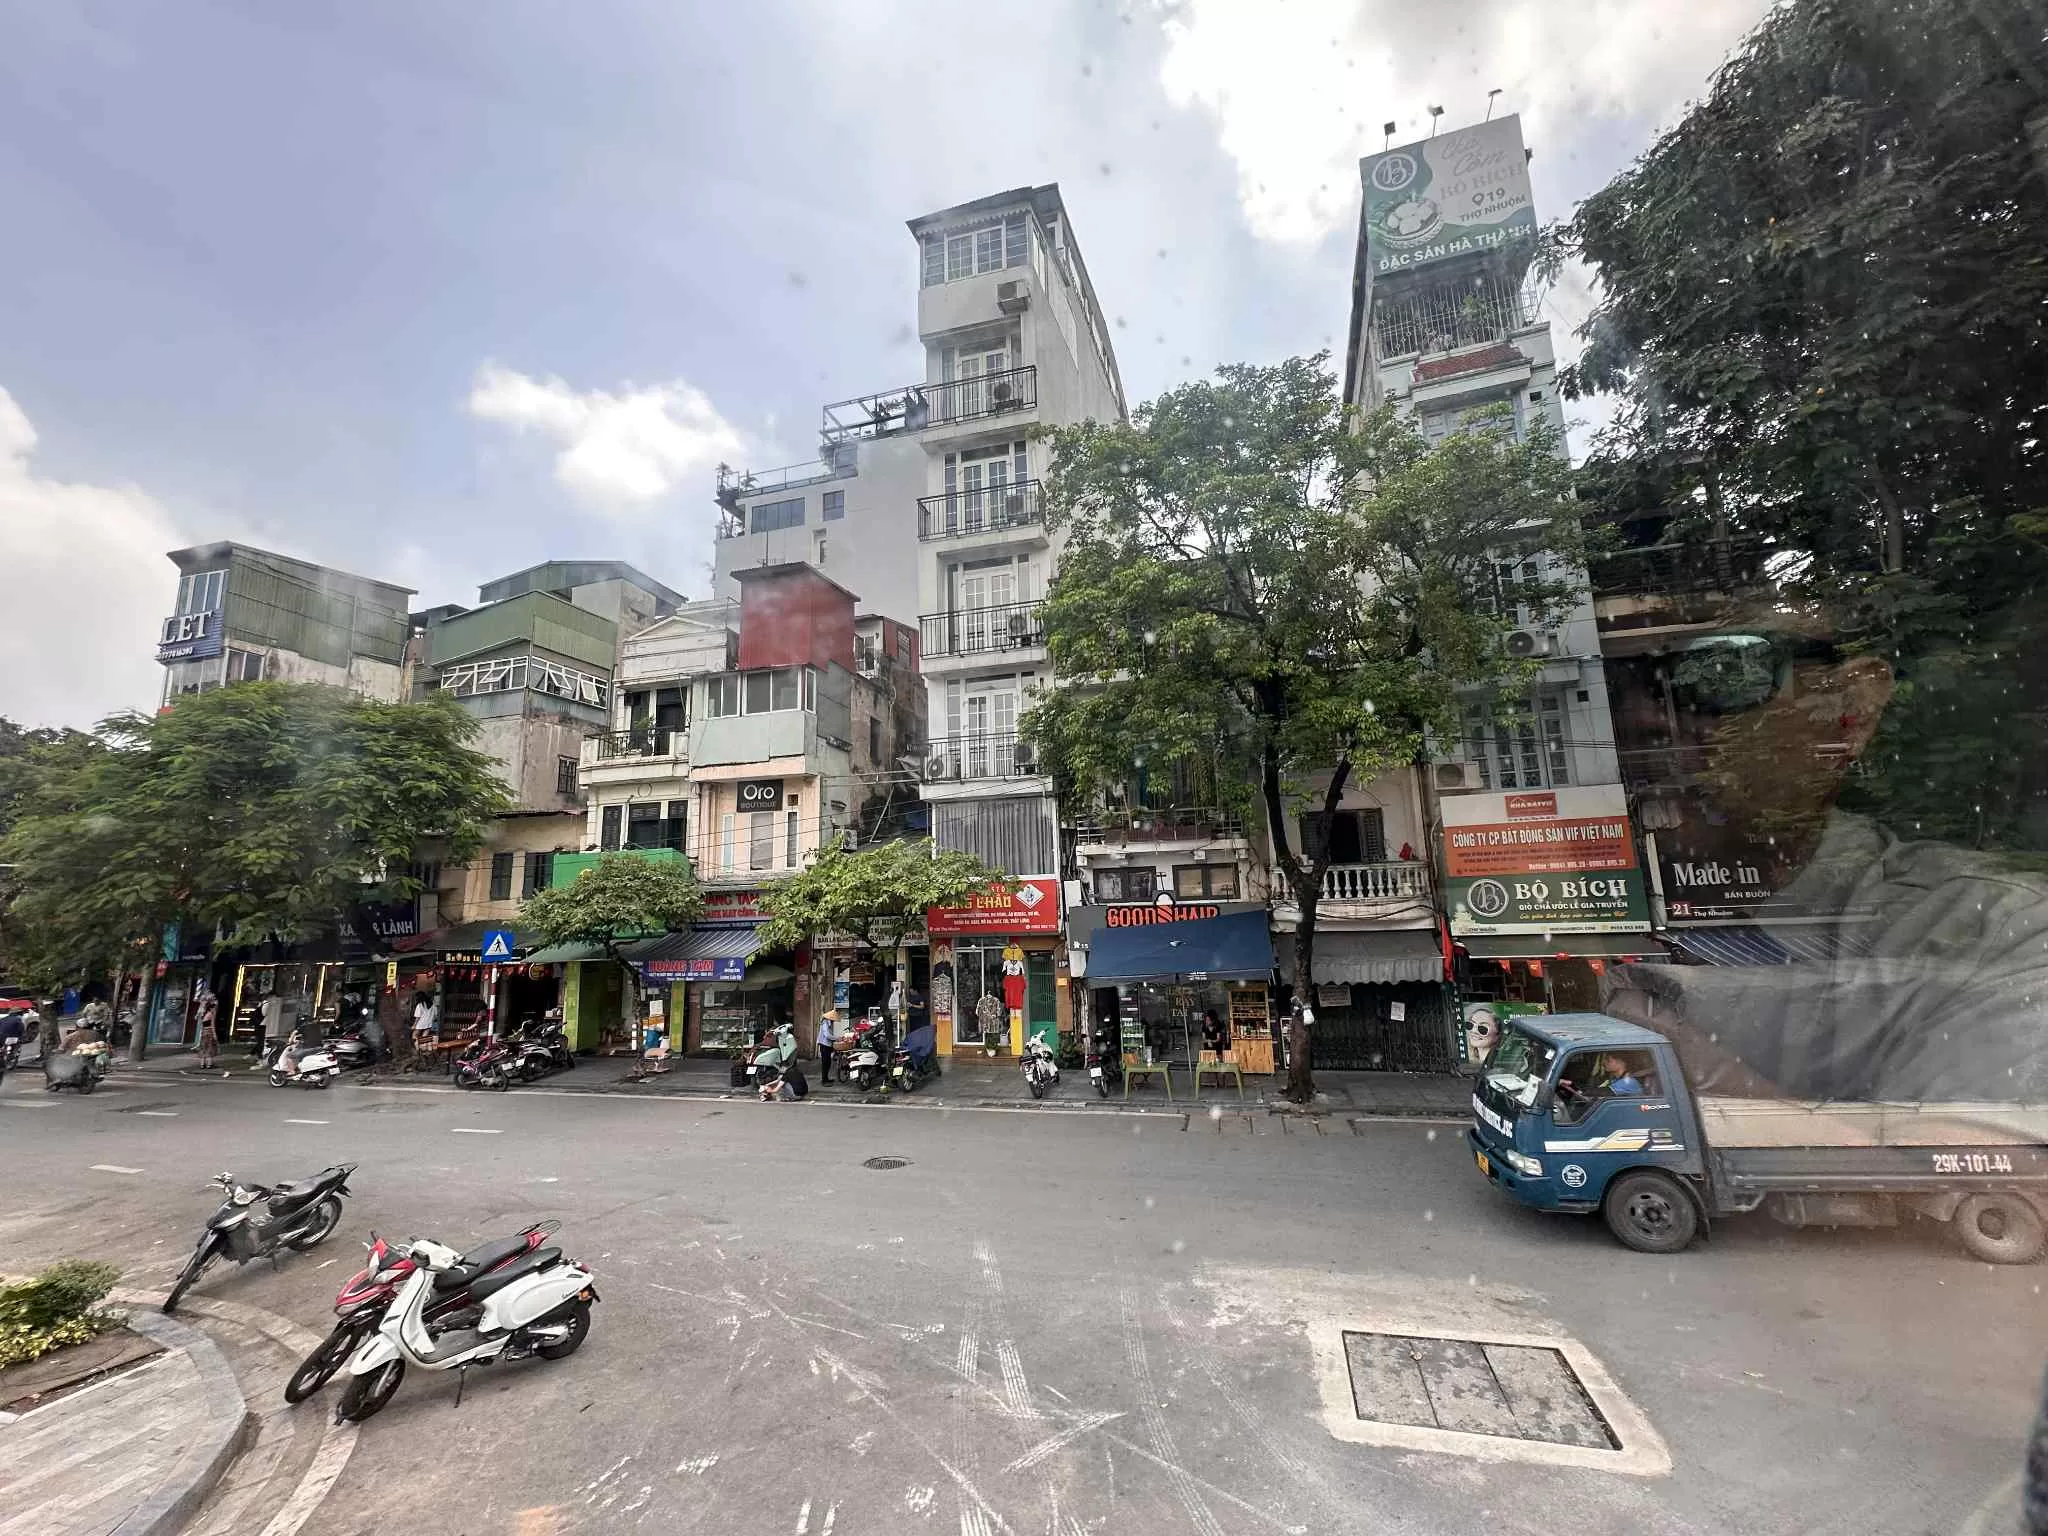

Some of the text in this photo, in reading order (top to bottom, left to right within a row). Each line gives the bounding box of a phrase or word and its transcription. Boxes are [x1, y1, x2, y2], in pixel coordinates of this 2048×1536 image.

[1487, 187, 1506, 202] 19
[1446, 236, 1473, 253] HÀ
[743, 785, 775, 800] Oro
[1452, 829, 1476, 848] CÔNG
[1477, 831, 1487, 847] TY
[1489, 831, 1500, 846] CP
[1520, 825, 1544, 848] ĐỘNG
[1546, 823, 1564, 842] SẢN
[1565, 826, 1578, 841] VIF
[1580, 823, 1600, 845] VIỆT
[1602, 823, 1625, 840] NAM
[1672, 860, 1761, 887] Made in
[1514, 877, 1628, 902] BỘ BÍCH
[1581, 901, 1594, 909] GIA
[1672, 903, 1691, 915] 21
[1107, 907, 1156, 927] GOOD
[382, 918, 414, 935] LÀNH
